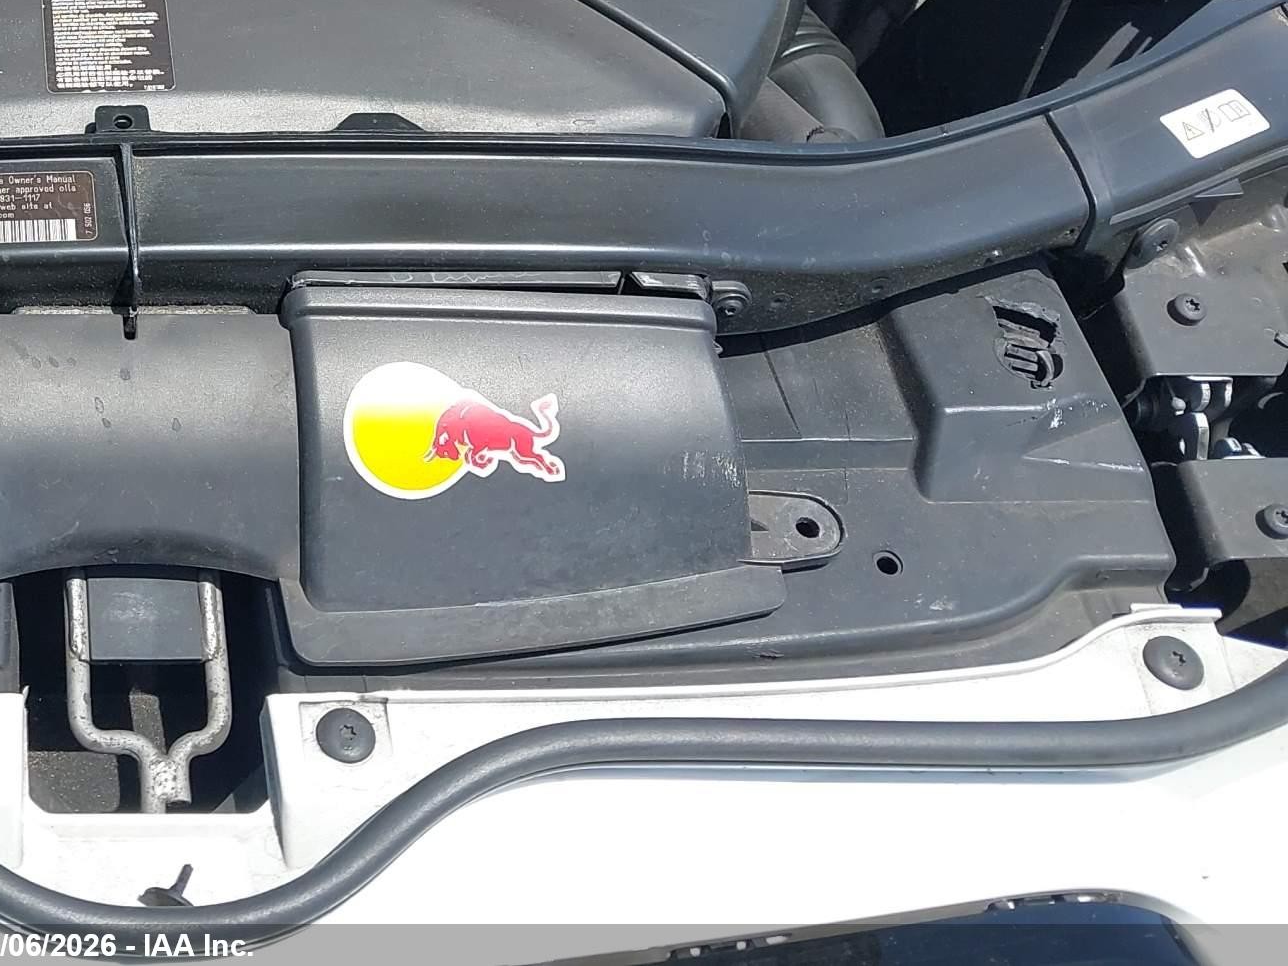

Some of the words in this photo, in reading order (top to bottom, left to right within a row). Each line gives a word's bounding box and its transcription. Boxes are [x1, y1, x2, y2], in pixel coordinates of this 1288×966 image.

[8, 175, 42, 185] Owner's
[46, 174, 76, 184] Manual
[15, 184, 55, 196] approved
[59, 183, 77, 192] oils
[0, 202, 16, 211] web
[21, 201, 39, 210] site
[43, 201, 53, 210] at
